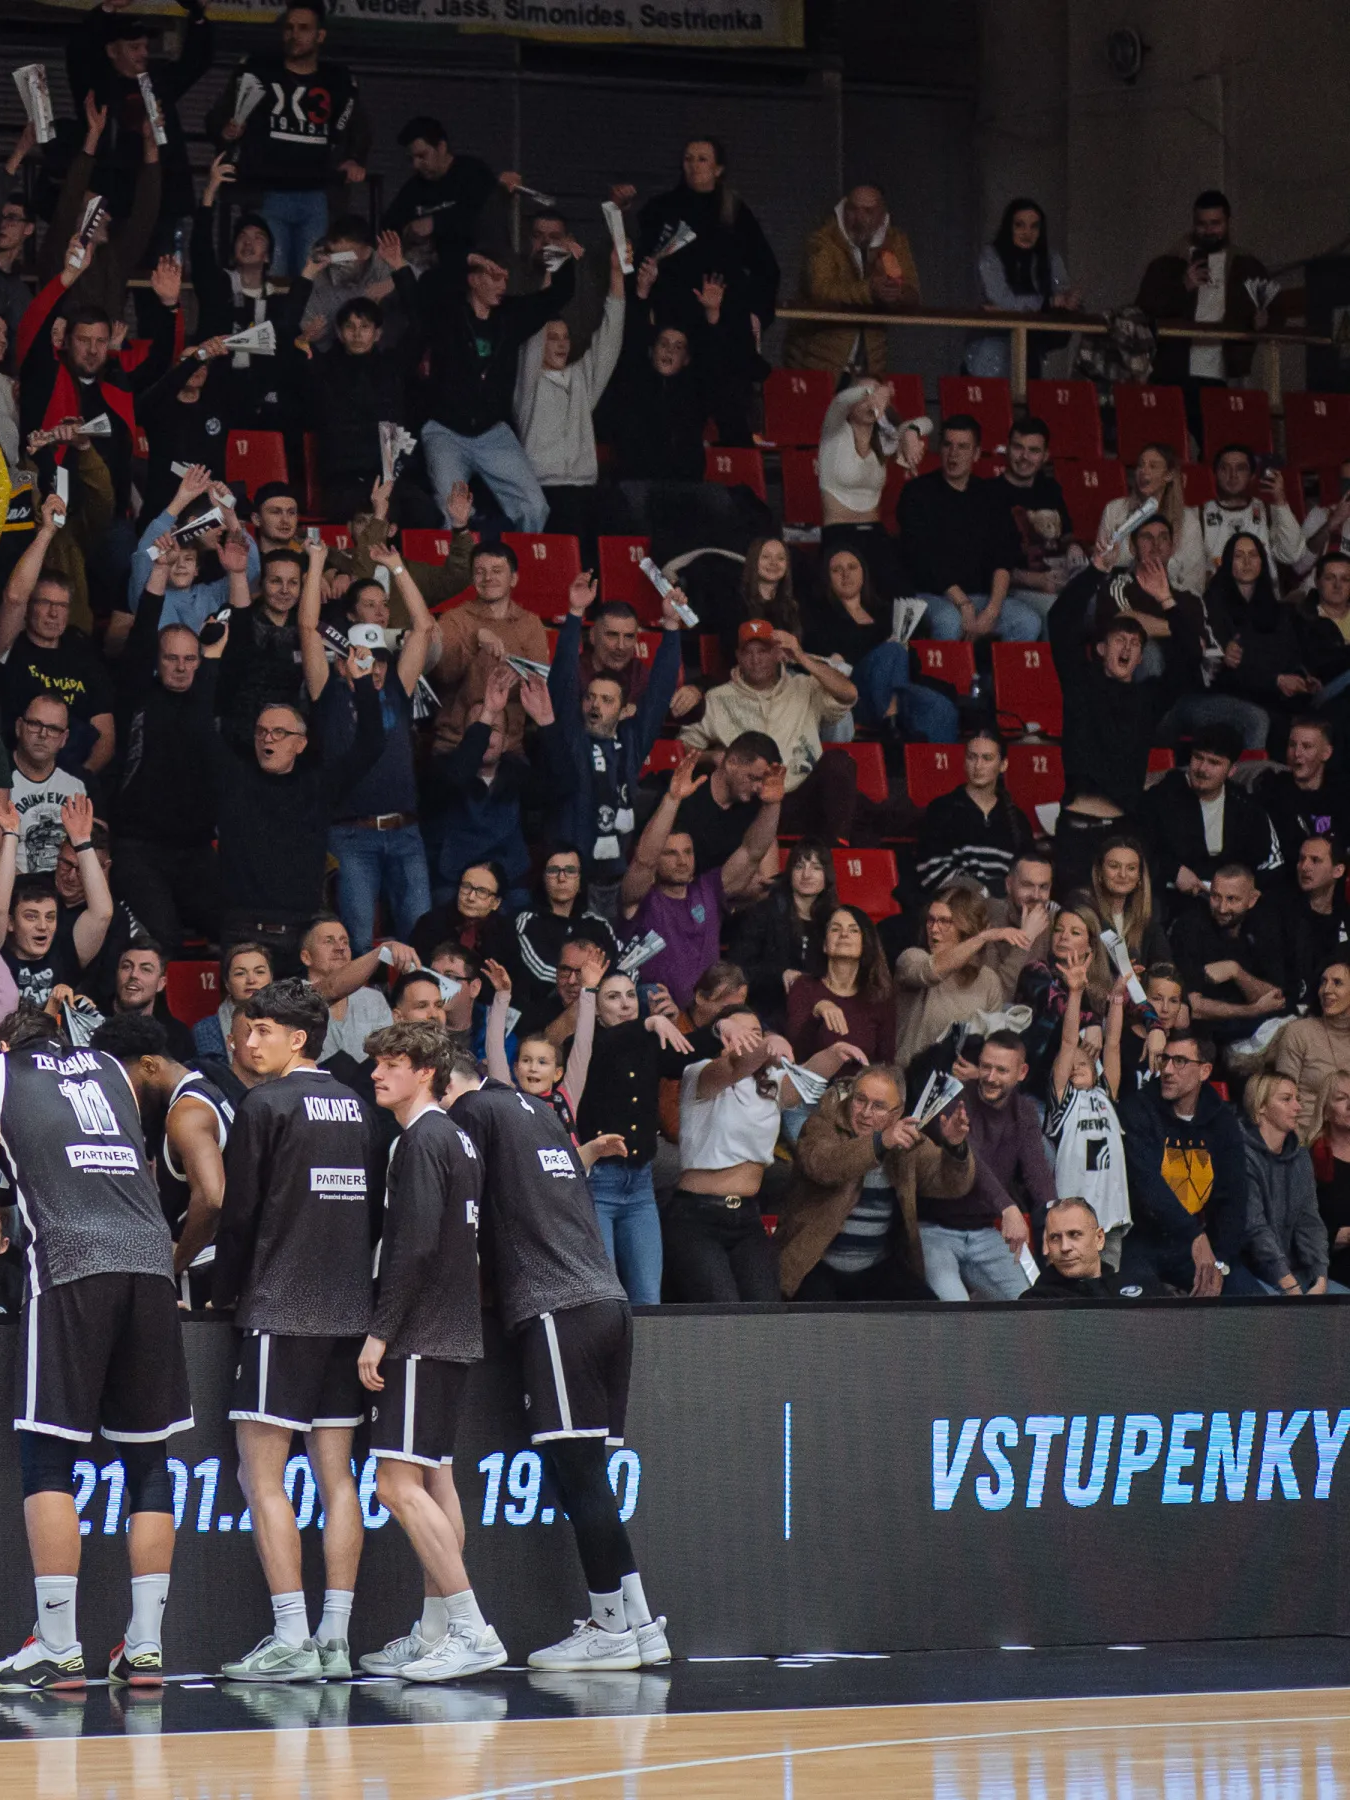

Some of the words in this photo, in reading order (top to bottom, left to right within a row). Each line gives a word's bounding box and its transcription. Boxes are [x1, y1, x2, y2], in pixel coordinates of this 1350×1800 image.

[639, 4, 764, 31] Sestrienka
[200, 972, 215, 990] 12
[303, 1096, 363, 1123] KOKAVEC
[74, 1151, 134, 1162] PARTNERS
[932, 1408, 1350, 1512] VSTUPENKY
